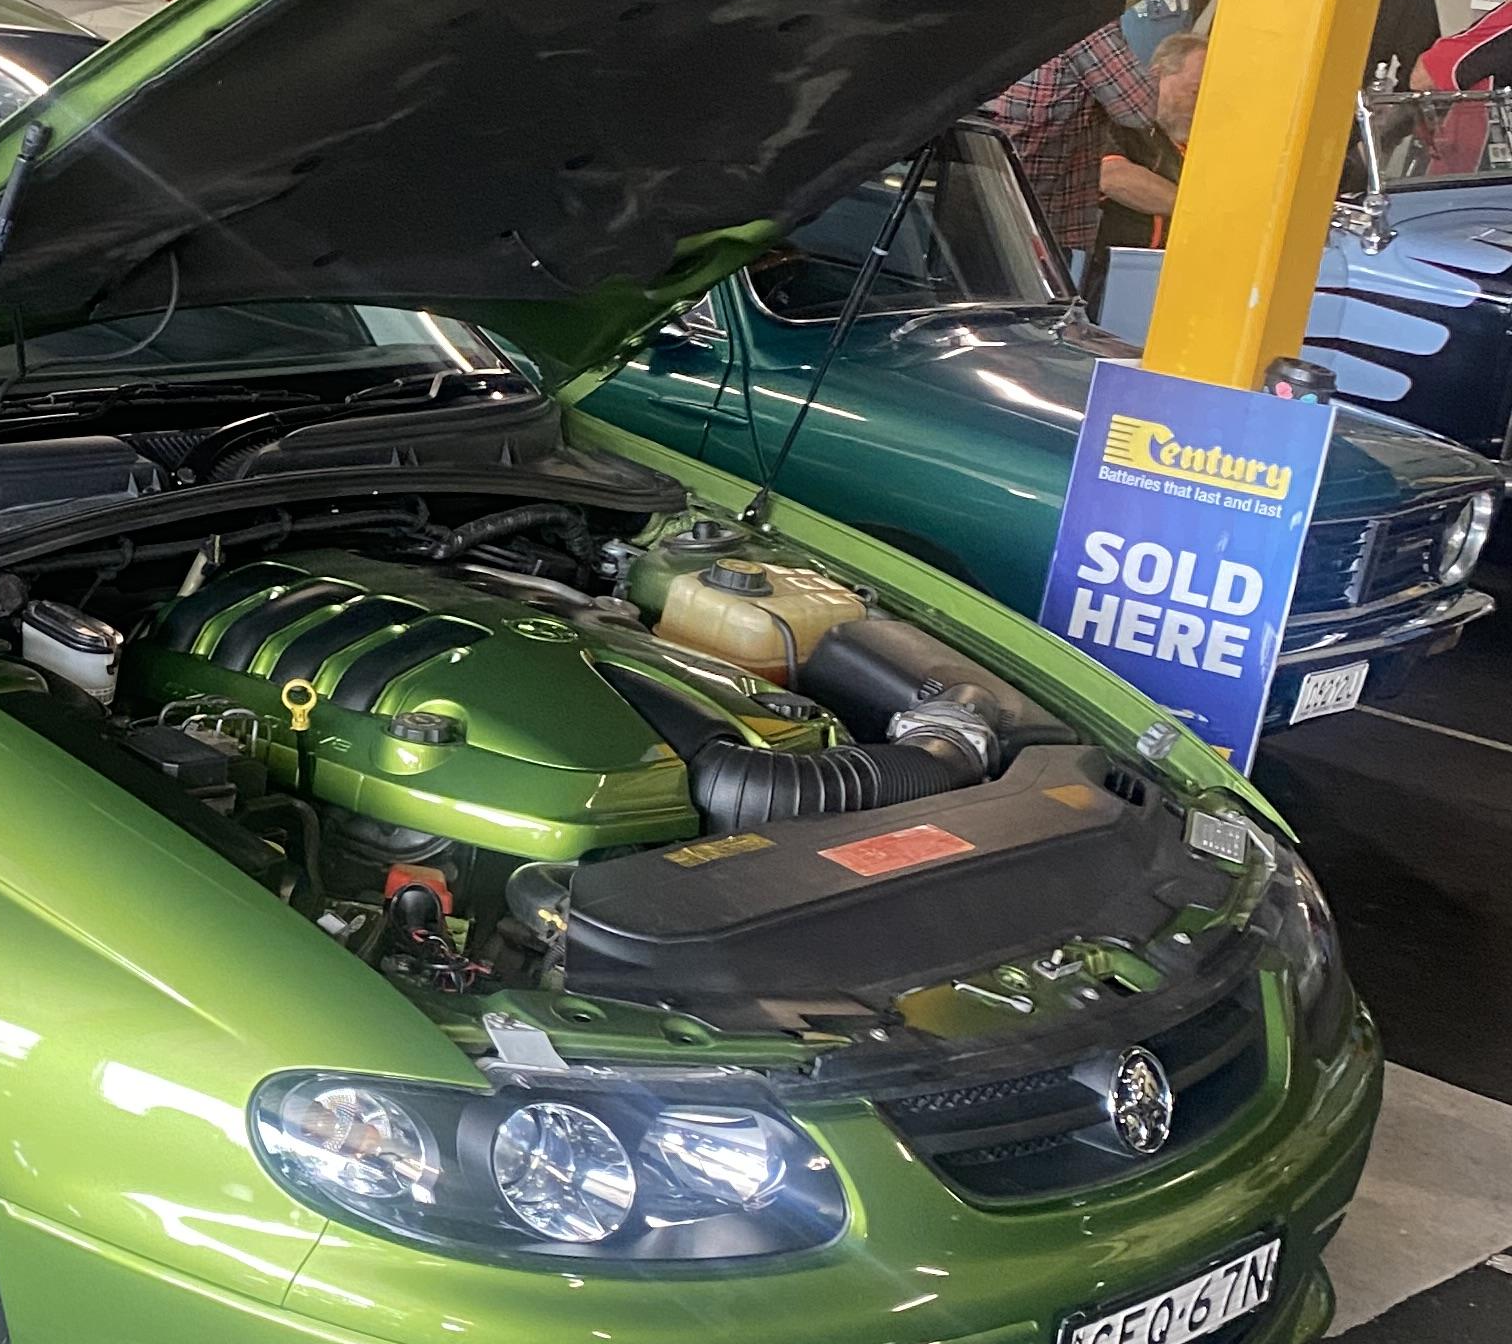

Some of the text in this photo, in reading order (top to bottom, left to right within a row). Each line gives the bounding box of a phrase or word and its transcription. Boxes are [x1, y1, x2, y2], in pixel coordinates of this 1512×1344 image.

[1098, 465, 1283, 519] Batteries that last and last
[1102, 414, 1292, 501] Century
[1076, 531, 1264, 617] SOLD
[1067, 587, 1251, 679] HERE
